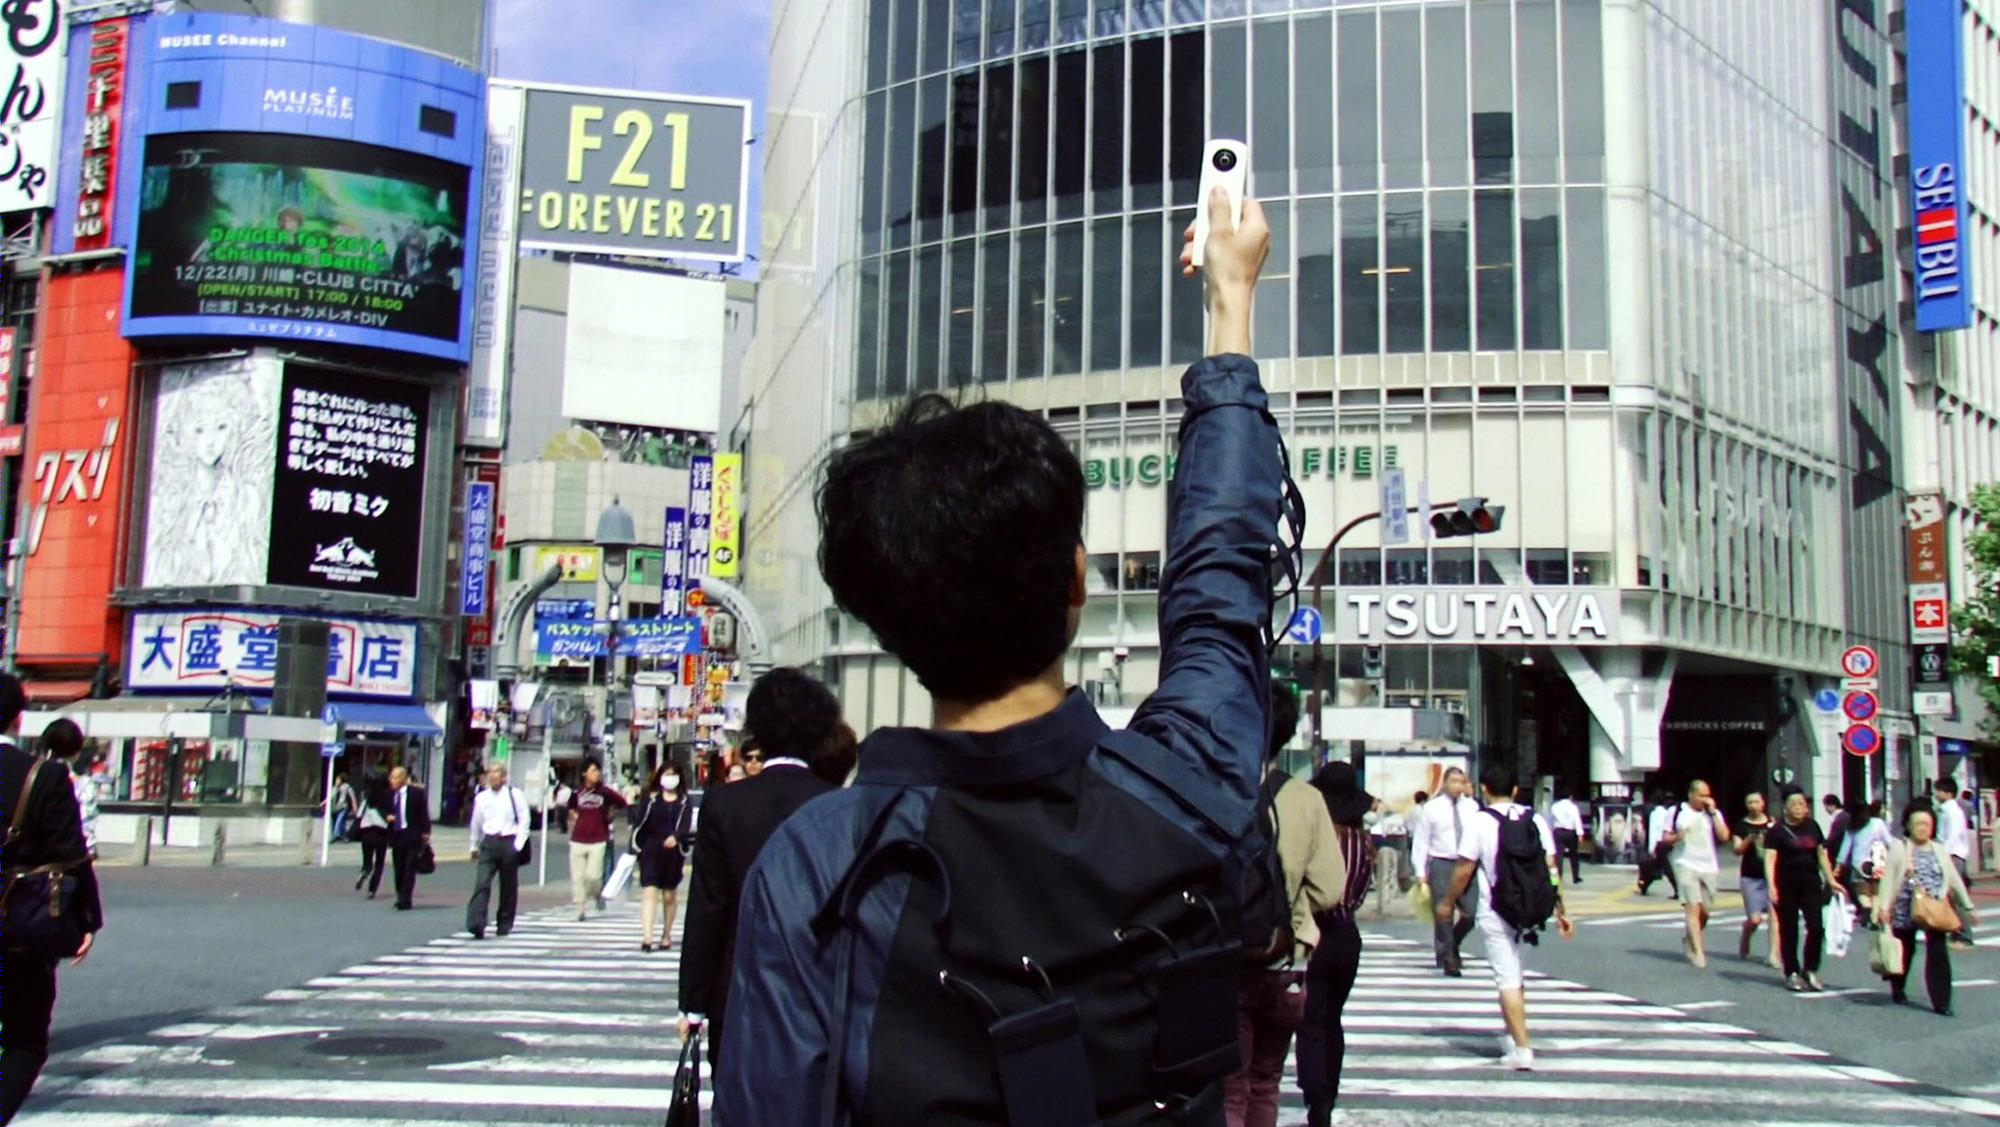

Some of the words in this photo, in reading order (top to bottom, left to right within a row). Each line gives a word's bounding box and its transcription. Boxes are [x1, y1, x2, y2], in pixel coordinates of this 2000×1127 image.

[160, 34, 212, 48] MUSEE
[217, 33, 287, 48] Channel
[567, 104, 691, 191] F21
[694, 203, 734, 242] 21
[1914, 162, 1959, 302] SEIBU
[309, 487, 390, 518] 初音ミク
[661, 522, 683, 620] 洋服の青
[1347, 593, 1607, 639] TSUTAYA
